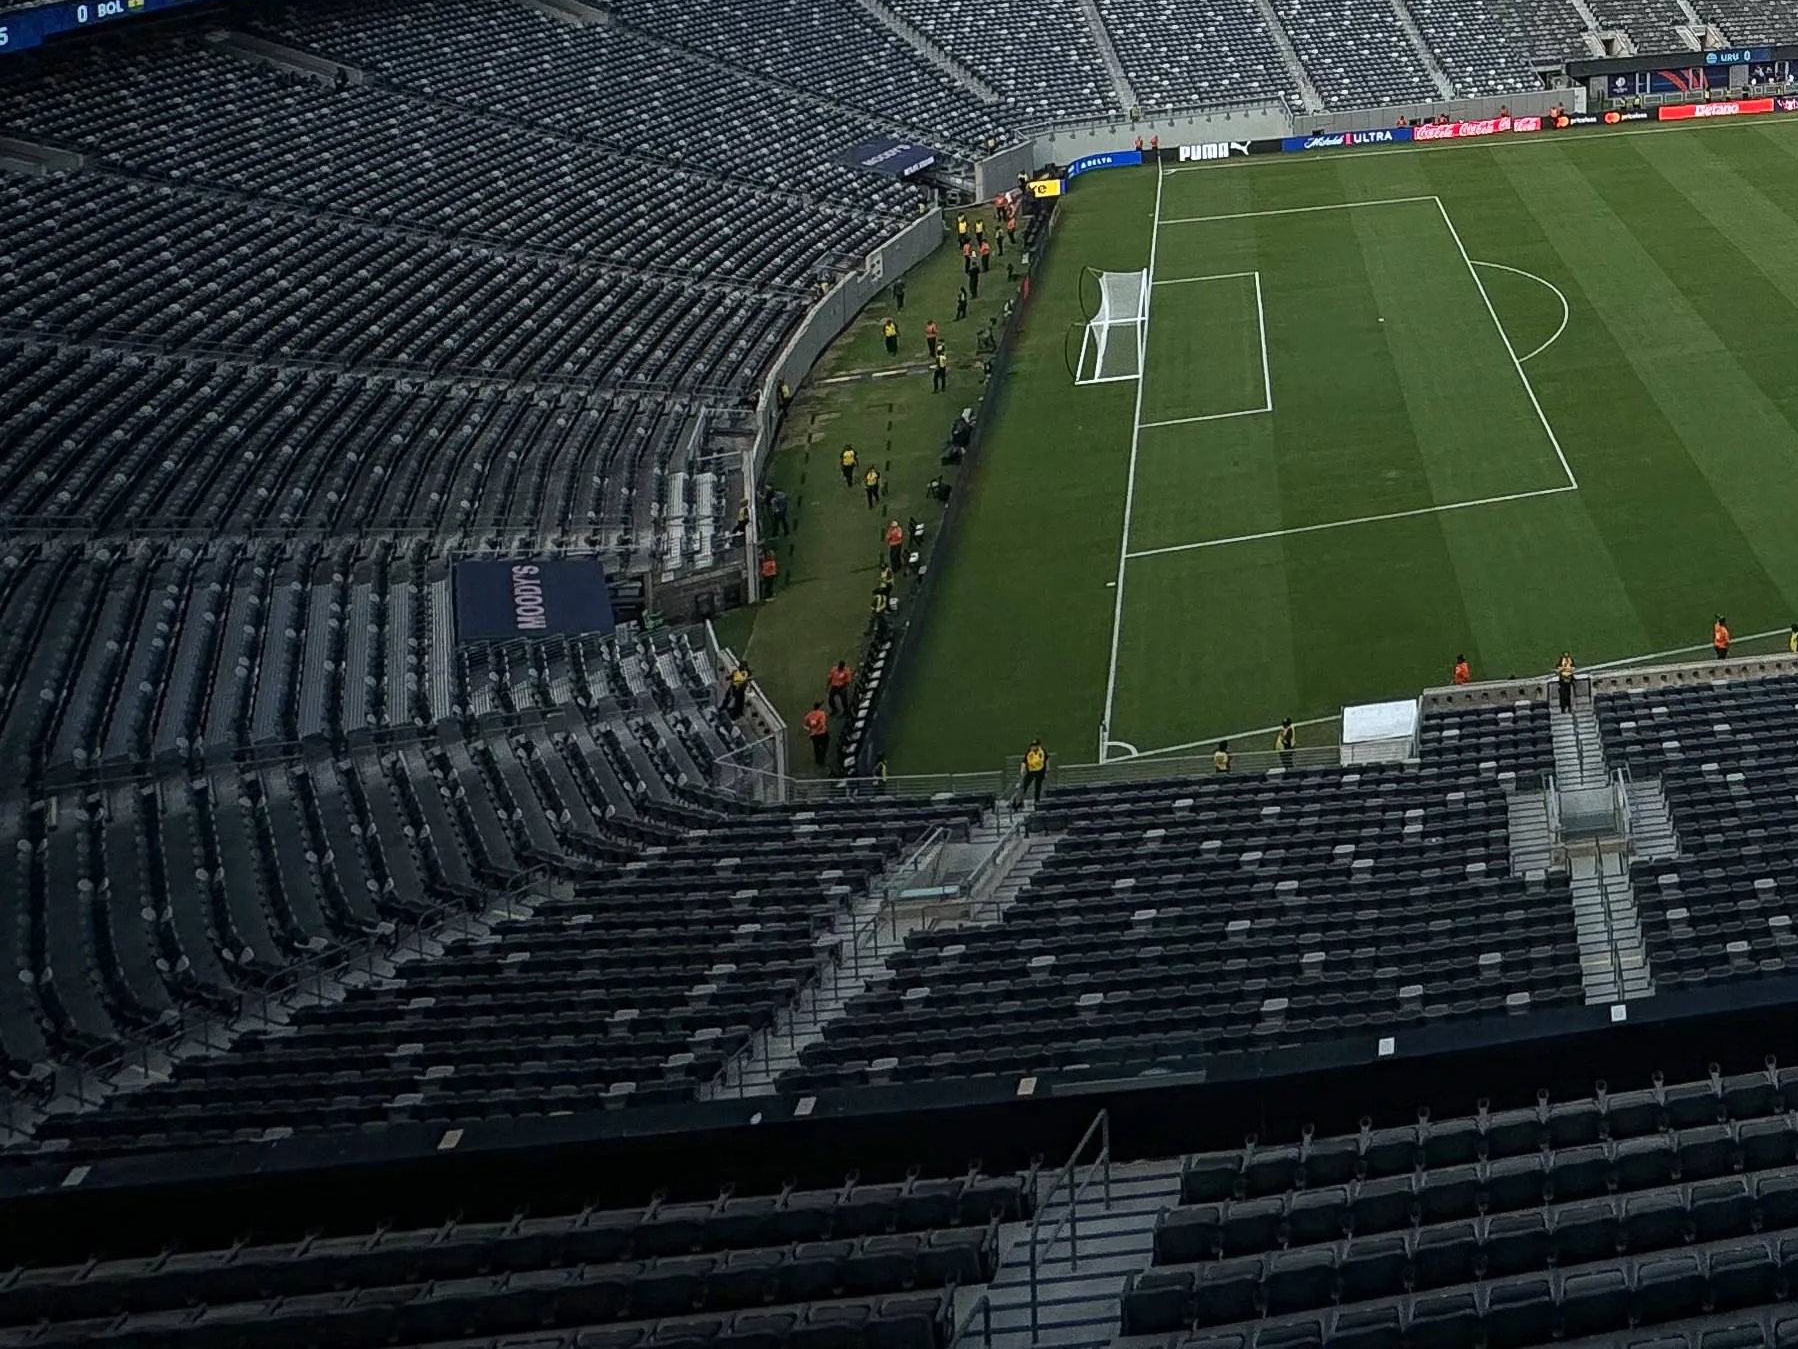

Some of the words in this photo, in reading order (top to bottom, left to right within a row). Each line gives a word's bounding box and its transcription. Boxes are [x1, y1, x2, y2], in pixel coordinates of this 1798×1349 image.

[77, 4, 88, 23] 0
[97, 0, 125, 19] BOL
[1694, 102, 1740, 116] Betano
[1354, 130, 1393, 143] ULTRA
[1179, 142, 1230, 162] PUMA
[511, 565, 547, 630] MOODY'S
